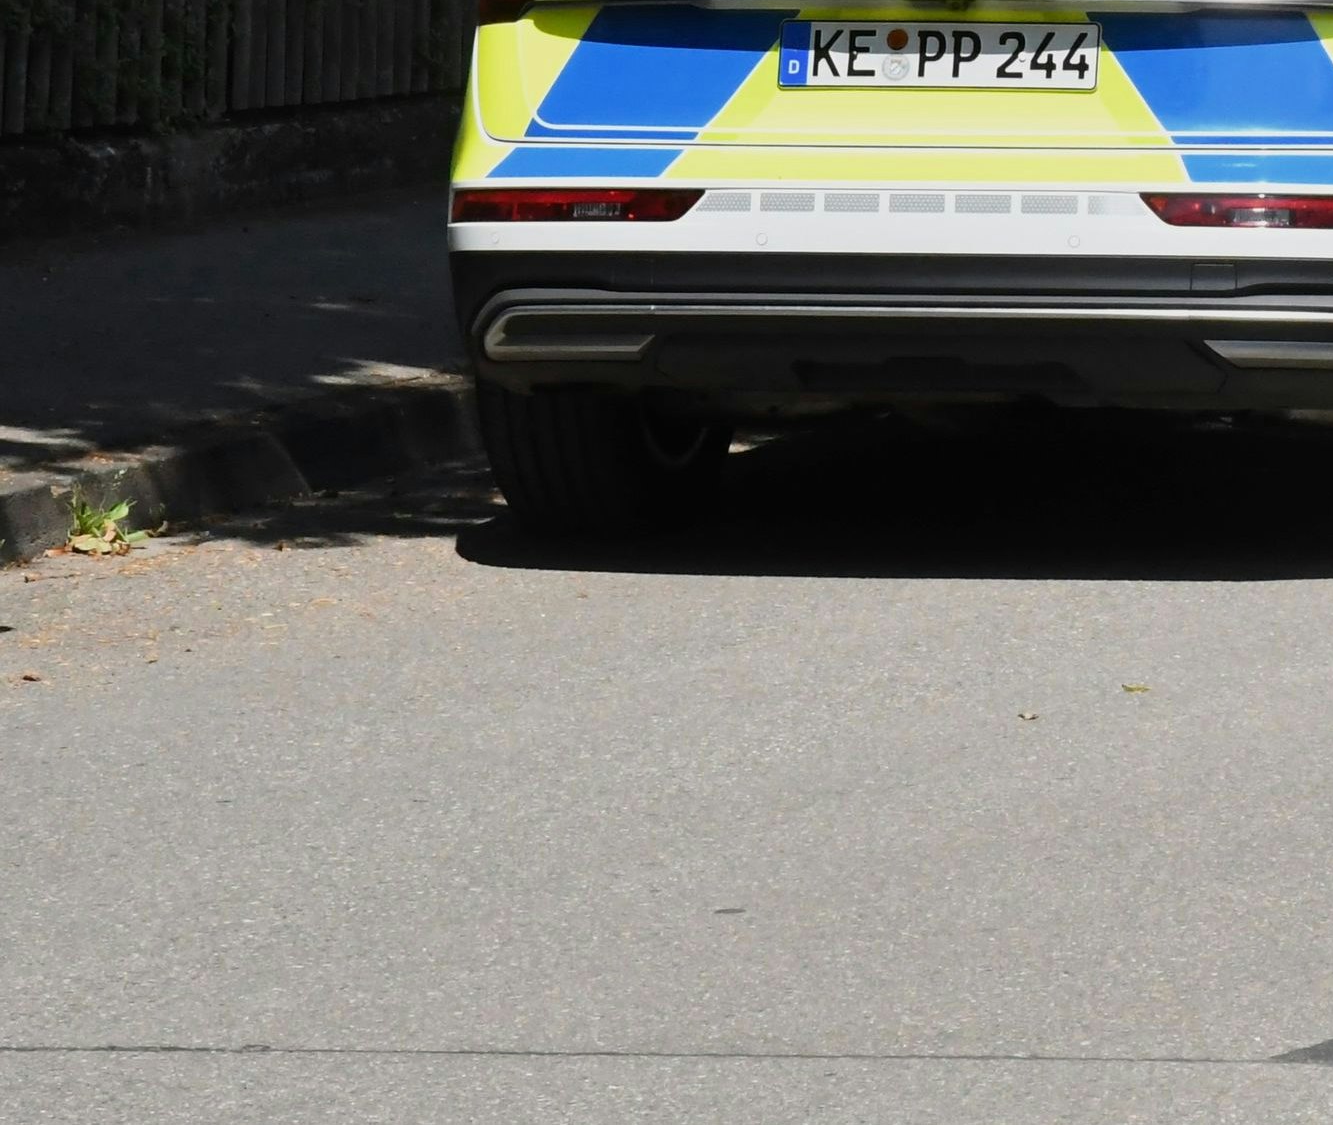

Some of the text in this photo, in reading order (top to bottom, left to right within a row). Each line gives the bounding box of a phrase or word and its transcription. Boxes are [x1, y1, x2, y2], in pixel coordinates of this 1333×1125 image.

[787, 29, 1090, 80] D KE PP 244
